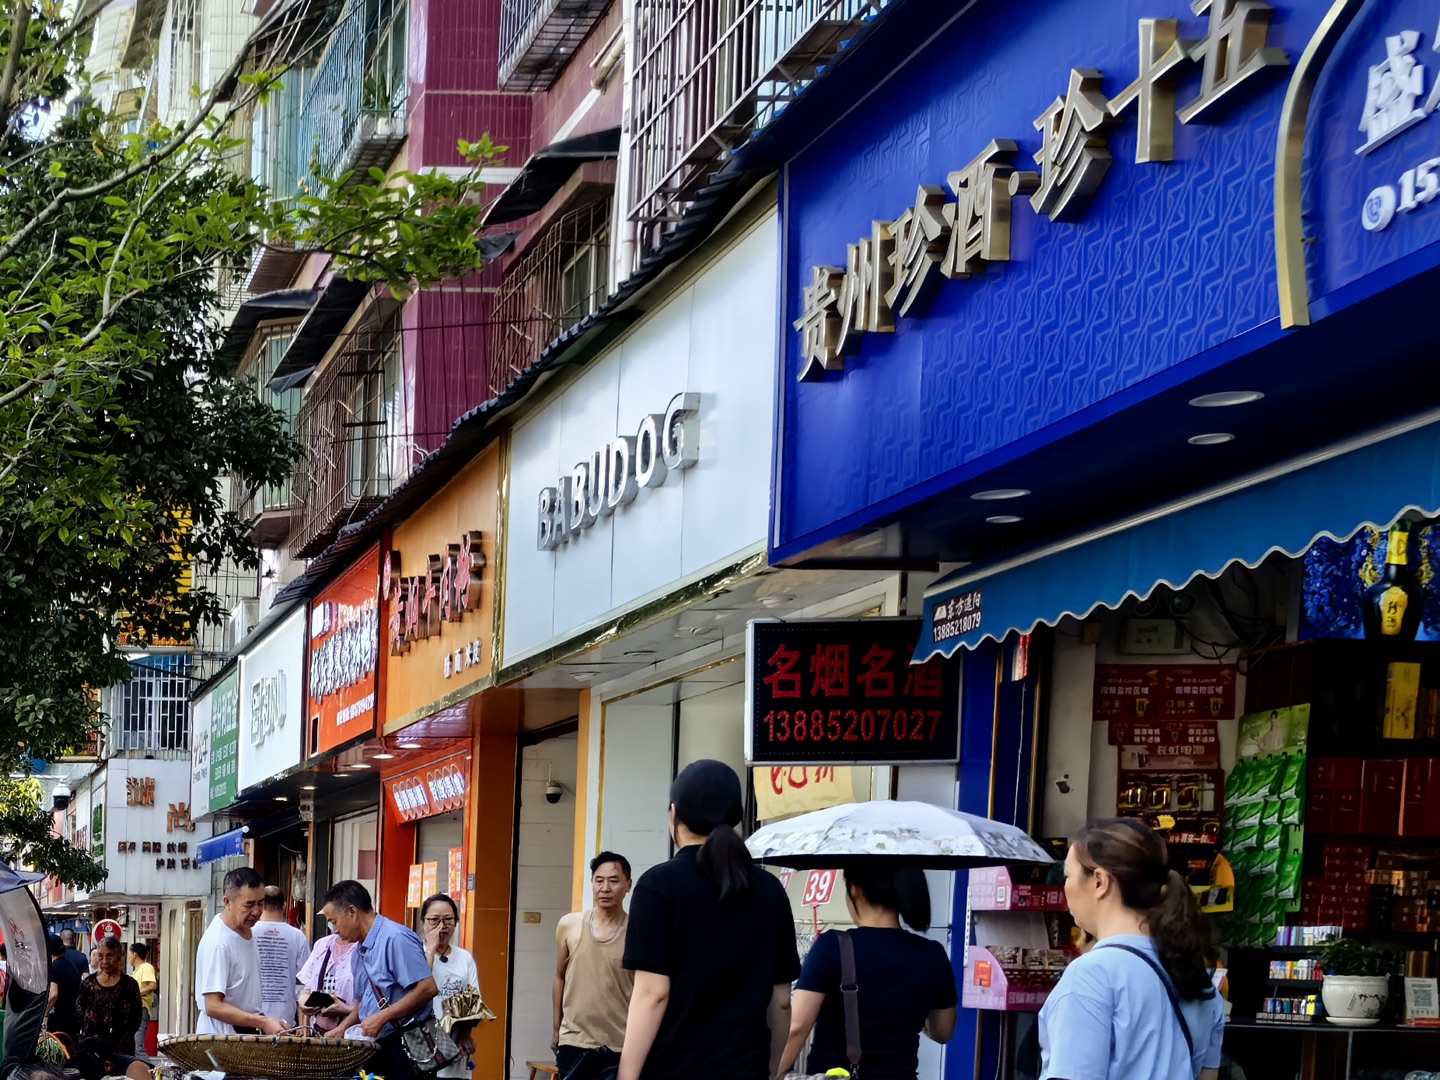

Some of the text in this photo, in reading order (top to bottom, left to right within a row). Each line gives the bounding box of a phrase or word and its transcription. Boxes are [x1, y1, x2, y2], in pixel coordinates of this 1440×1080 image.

[537, 391, 701, 551] BABUDOG
[932, 611, 982, 642] 13885218079
[763, 642, 942, 699] 名烟名酒
[763, 709, 942, 742] 13885207027
[805, 870, 831, 902] 39
